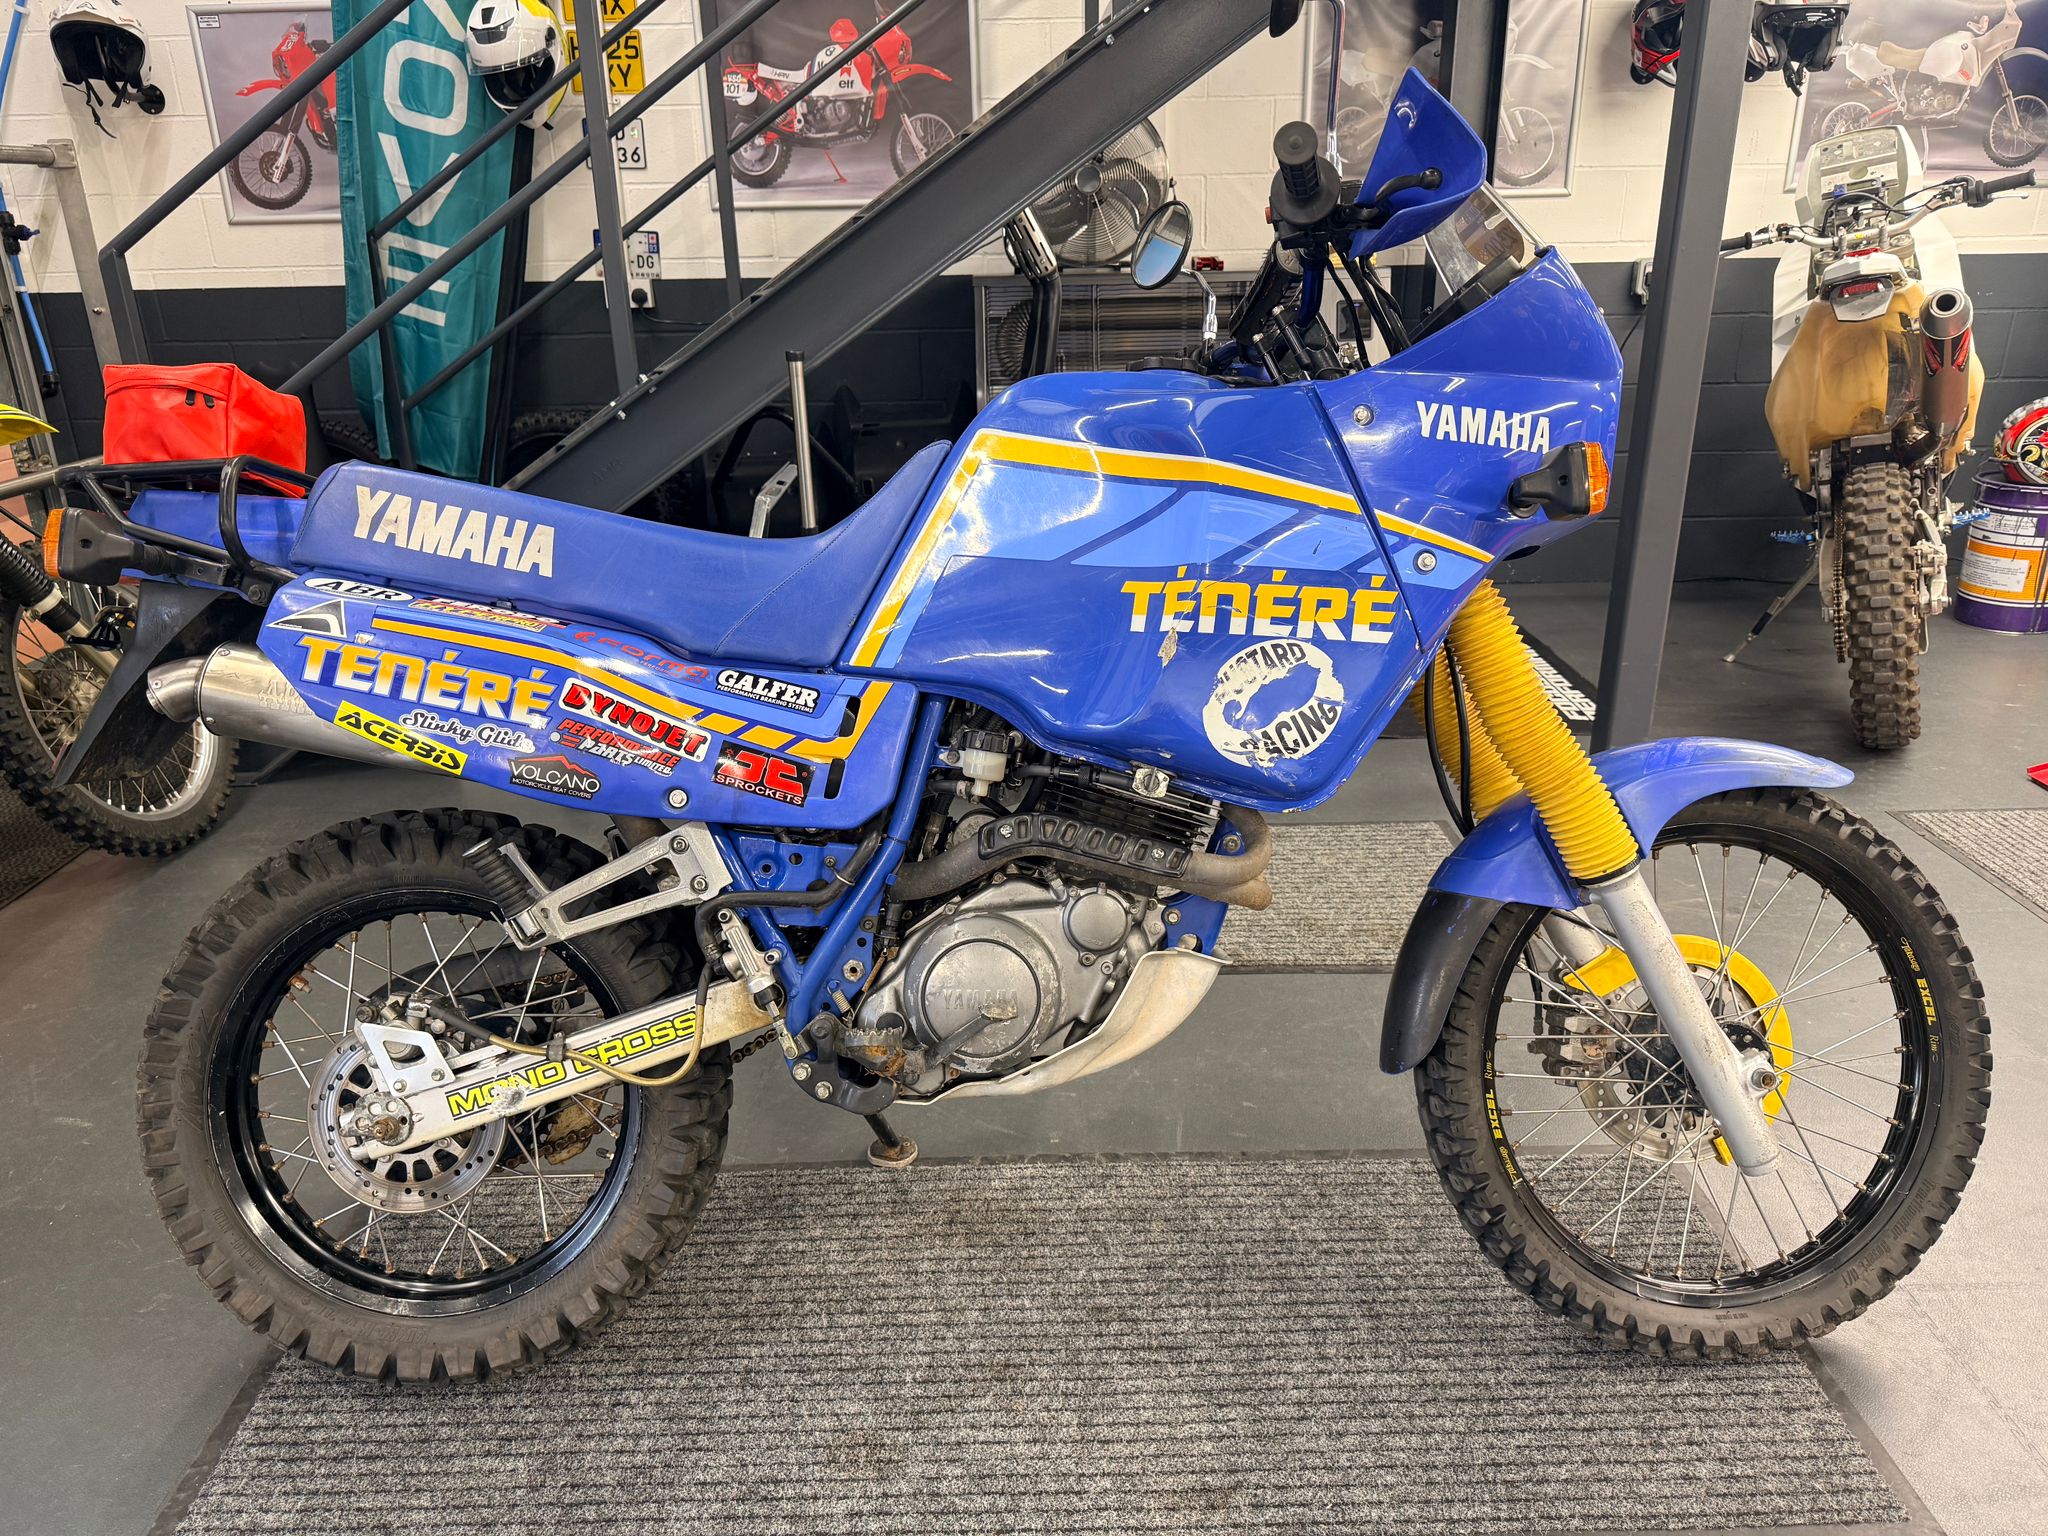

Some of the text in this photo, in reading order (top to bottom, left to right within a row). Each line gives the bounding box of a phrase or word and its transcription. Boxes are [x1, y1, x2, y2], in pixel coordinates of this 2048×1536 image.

[726, 83, 740, 95] 101
[838, 78, 854, 89] elf
[1416, 400, 1550, 455] YAMAHA
[353, 485, 555, 578] YAMAHA
[317, 581, 403, 600] ABR
[1120, 565, 1399, 644] TÉNÉRÉ
[717, 669, 818, 708] GALFER
[1215, 642, 1307, 704] STARD
[716, 684, 814, 713] PERFORMANCE BRAKING SYSTEMS
[401, 711, 533, 750] Slinky Glid
[563, 682, 708, 757] DYNOJET
[338, 711, 462, 770] ACERBIS
[578, 737, 673, 776] PARTS LIMITED
[510, 761, 600, 793] VOLCANO
[512, 777, 593, 799] MOTORCYCLE SEAT COVERS
[715, 774, 803, 805] SPROCKETS
[1916, 977, 1937, 1026] EXCEL
[574, 1011, 697, 1074] CROSS
[1486, 1088, 1504, 1139] EXCEL
